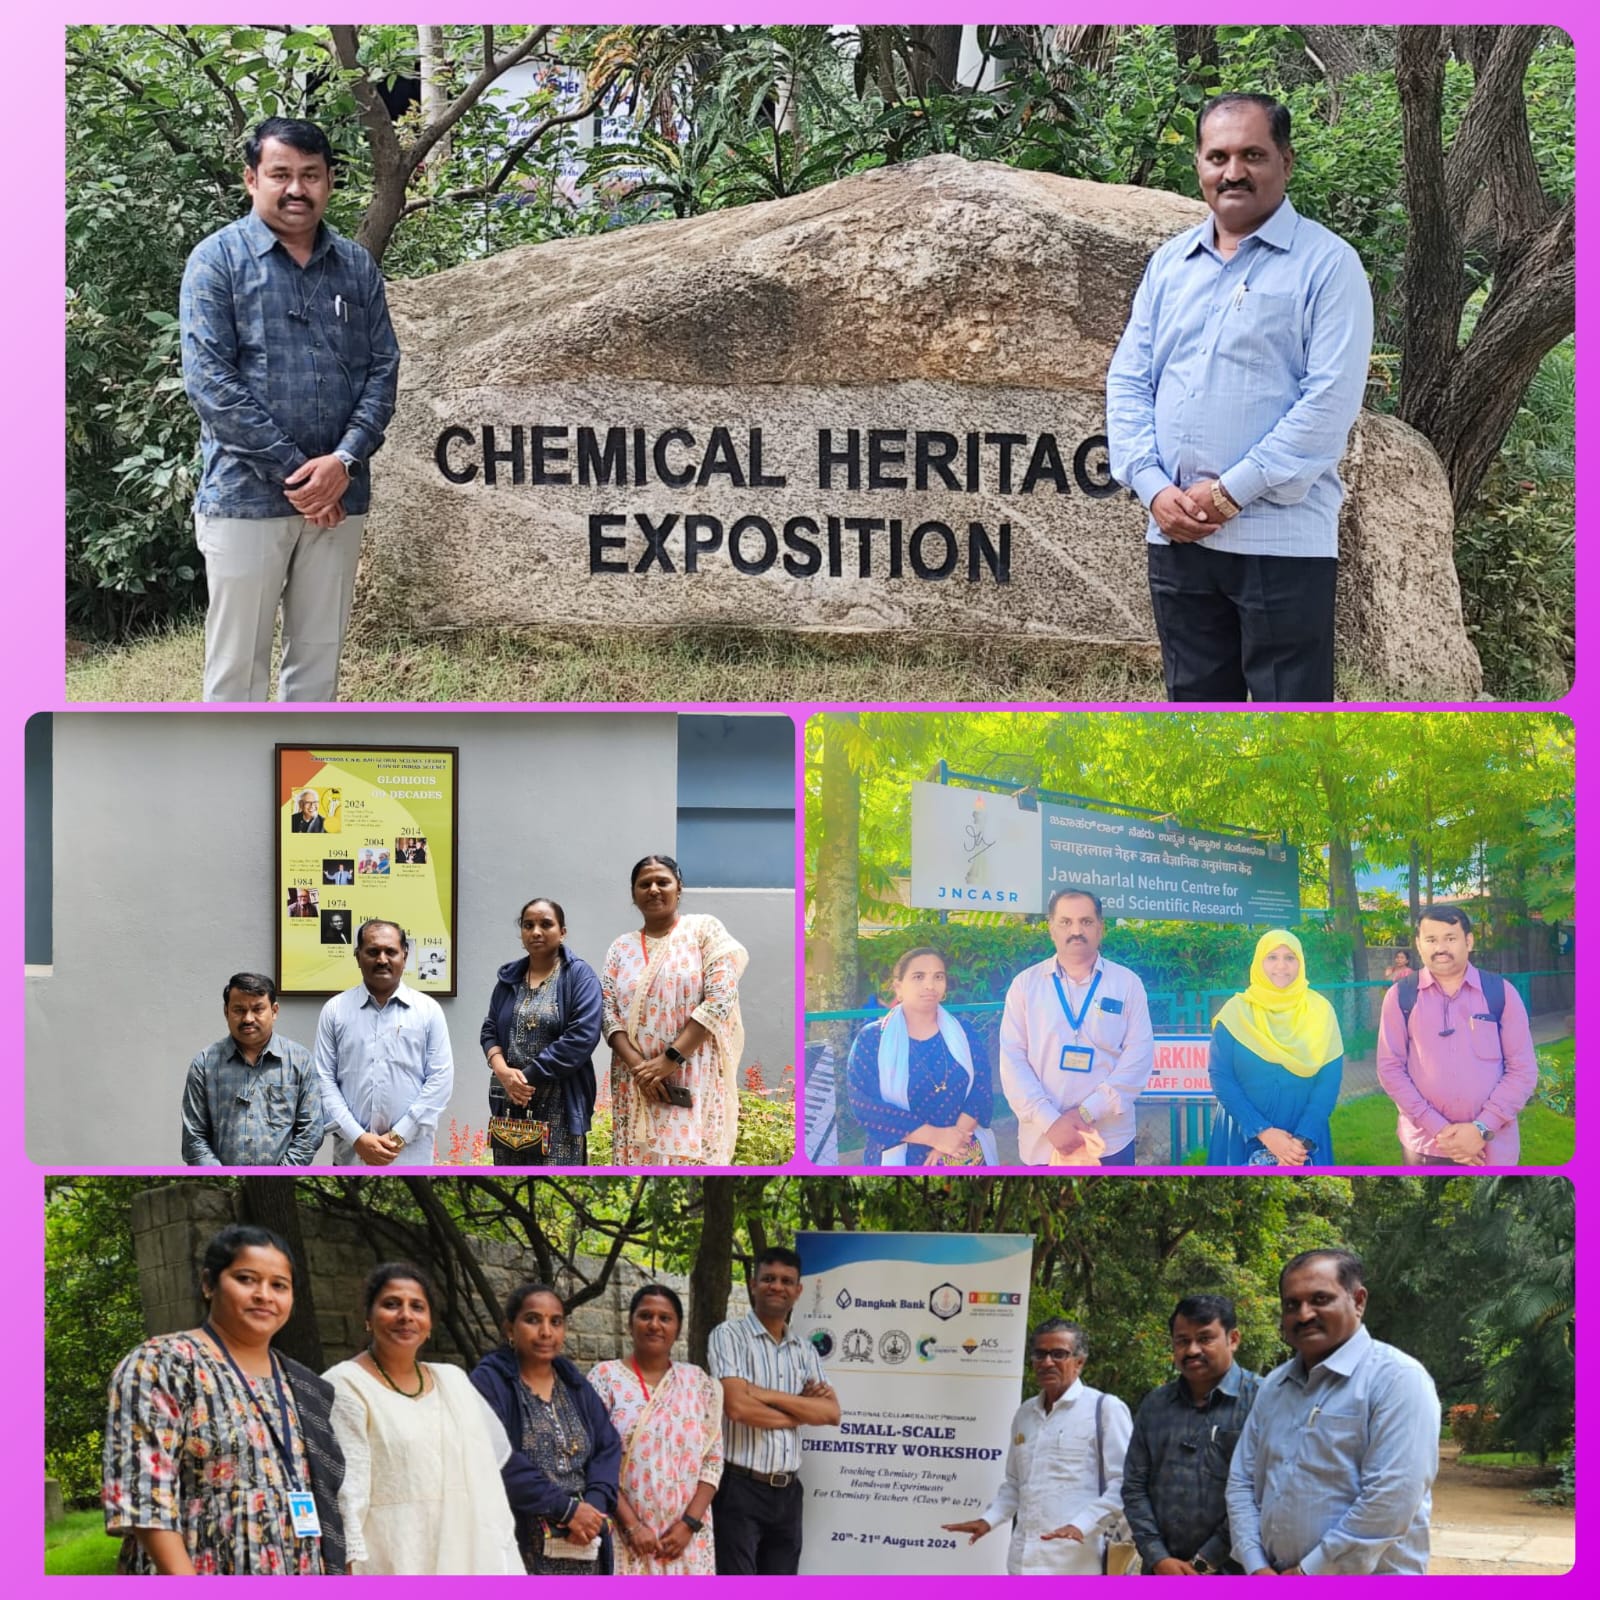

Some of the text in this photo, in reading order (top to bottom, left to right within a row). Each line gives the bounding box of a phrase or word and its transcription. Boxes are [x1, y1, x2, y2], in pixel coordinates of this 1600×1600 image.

[435, 425, 1122, 499] CHEMICAL HERITAG
[589, 513, 1012, 583] EXPOSITION
[377, 775, 436, 785] GLORIOUS
[390, 790, 443, 800] DECADES
[344, 799, 365, 809] 2024
[400, 827, 421, 836] 2014
[363, 838, 385, 847] 2004
[1049, 839, 1113, 858] जवाहरलाल
[328, 849, 348, 858] 1994
[293, 877, 313, 886] 1984
[1047, 866, 1239, 897] Jawaharlal Nehru Centre for
[938, 887, 1018, 903] JNCASR
[327, 899, 347, 908] 1974
[1047, 889, 1125, 910] Aced
[1128, 895, 1190, 914] Scientific
[1192, 900, 1244, 917] Research
[423, 937, 443, 946] 1944
[1153, 1046, 1207, 1069] RKIN
[1147, 1077, 1213, 1089] TAFF ONL
[854, 1297, 926, 1310] Bangkok Bank
[980, 1338, 999, 1348] ACS
[840, 1422, 956, 1440] SMALL-SCALE
[801, 1439, 1003, 1461] CHEMISTRY WORKSHOP
[839, 1465, 958, 1482] Teaching Chemistry Through
[850, 1478, 944, 1492] Hands-on Experiments
[813, 1488, 828, 1497] For
[830, 1489, 871, 1501] Chemistry
[873, 1492, 909, 1502] Teachers
[912, 1494, 939, 1505] (Class
[882, 1535, 924, 1549] August
[926, 1538, 957, 1549] 2024
